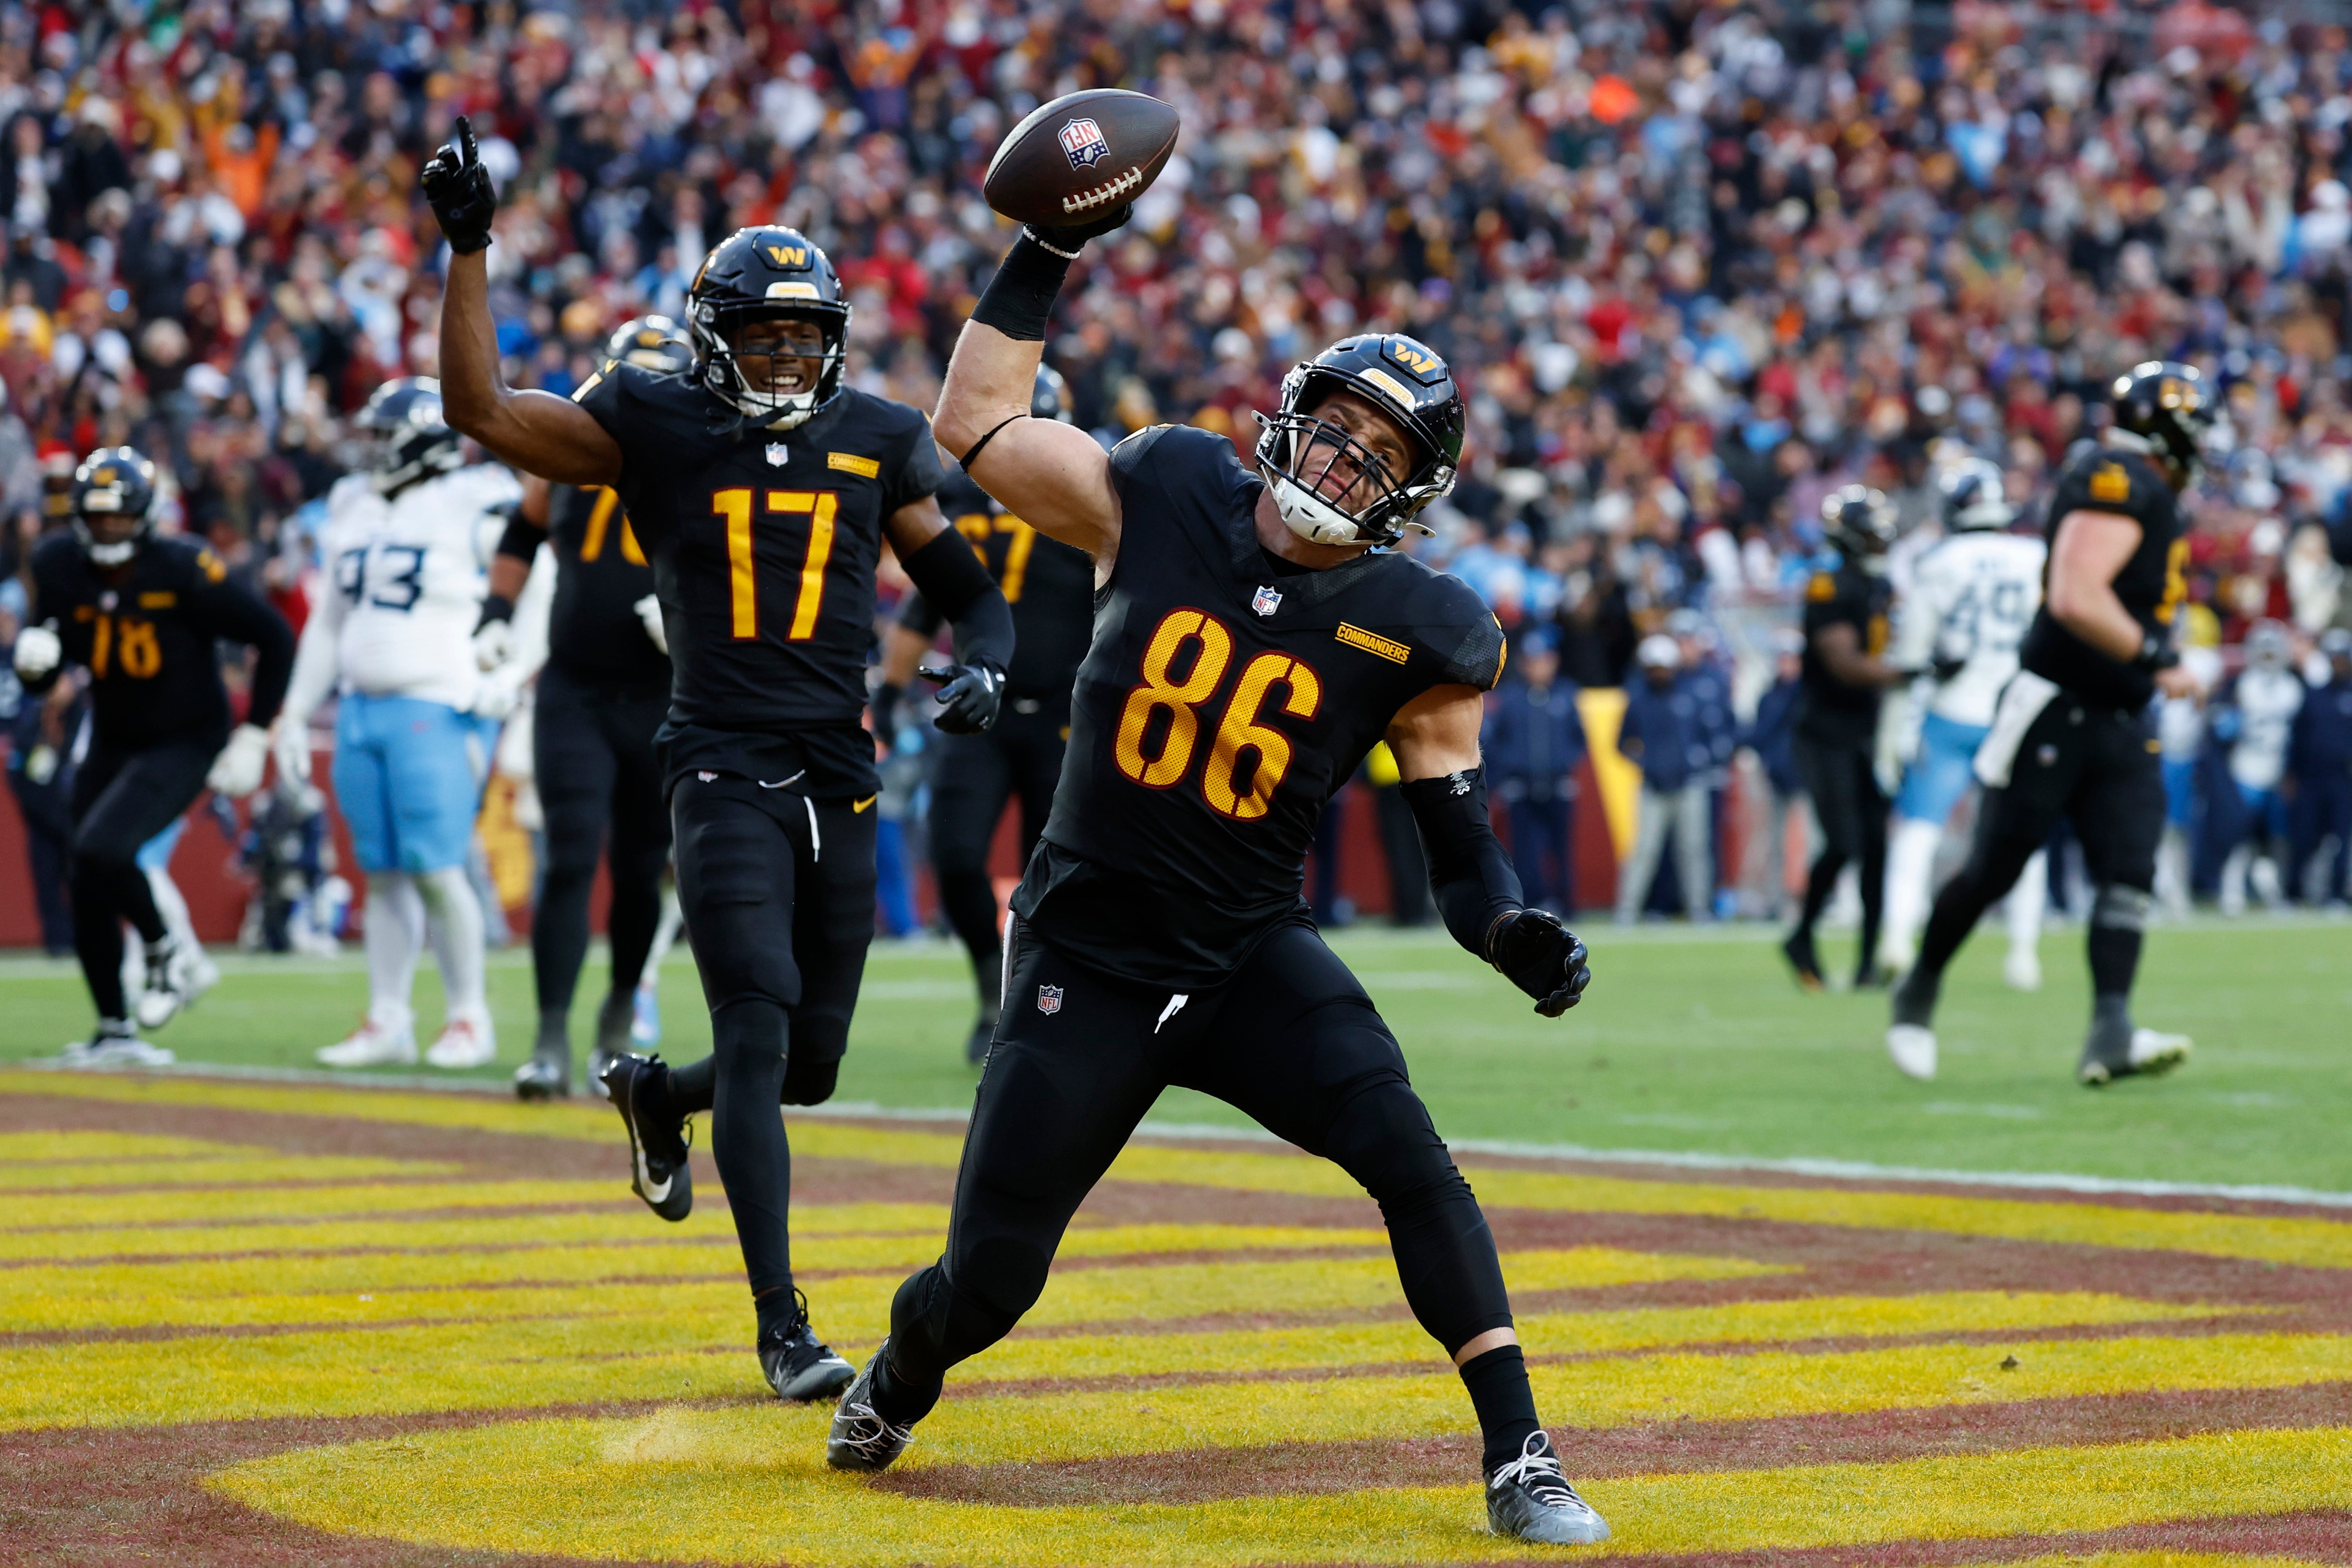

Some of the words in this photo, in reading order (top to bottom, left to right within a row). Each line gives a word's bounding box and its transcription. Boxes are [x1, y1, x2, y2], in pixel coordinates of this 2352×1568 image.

[1063, 123, 1098, 150] NFL
[1369, 370, 1411, 403] COMMANDERS
[332, 542, 427, 615] 93
[710, 485, 841, 642] 17
[1256, 597, 1273, 611] NFL
[1336, 625, 1410, 662] COMMANDERS
[1112, 606, 1324, 822] 86
[1041, 997, 1057, 1009] NFL
